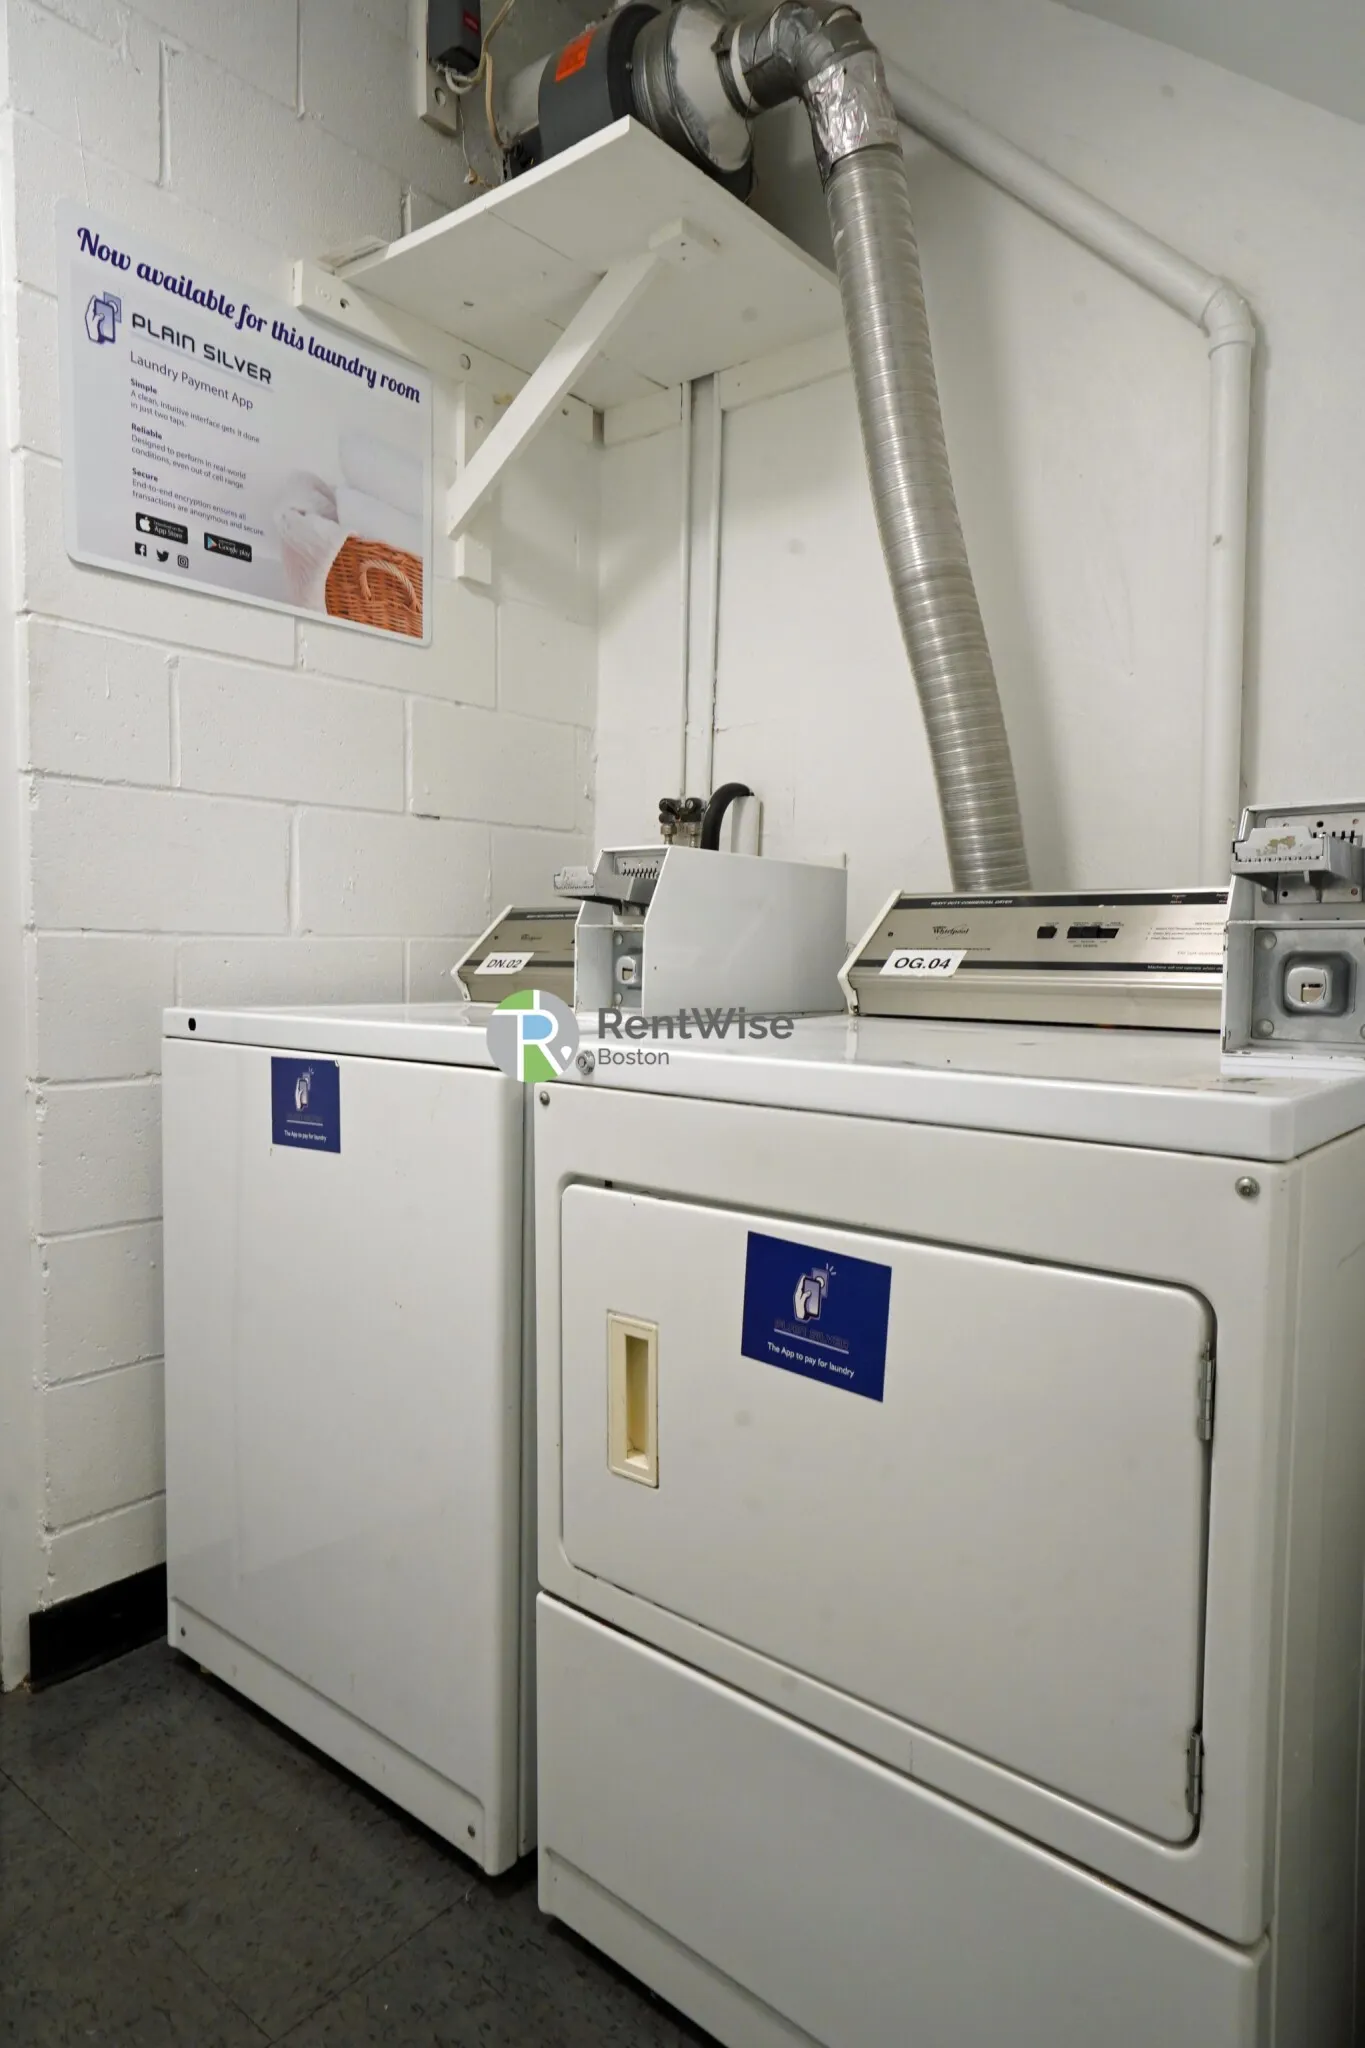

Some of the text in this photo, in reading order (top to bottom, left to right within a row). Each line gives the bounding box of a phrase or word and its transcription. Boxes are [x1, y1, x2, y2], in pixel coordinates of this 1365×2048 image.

[77, 227, 420, 403] Now available for this laundry room
[132, 313, 272, 385] PLAIN SILVER
[130, 350, 254, 410] Laundry Payment App
[130, 378, 157, 394] Simple
[130, 401, 138, 409] in
[138, 404, 153, 416] just
[154, 408, 168, 420] two
[130, 389, 137, 398] A
[138, 392, 159, 407] clean,
[160, 400, 189, 417] intuitive
[190, 411, 220, 429] interface
[221, 423, 236, 436] gets
[243, 431, 260, 443] done
[131, 422, 163, 441] Reliable
[131, 433, 167, 452] Designed
[176, 450, 204, 466] perform
[205, 459, 212, 467] in
[213, 461, 246, 480] real-world
[131, 446, 171, 466] conditions,
[172, 459, 189, 471] even
[190, 464, 203, 476] out
[204, 469, 211, 478] of
[212, 472, 223, 483] cell
[132, 467, 158, 482] Secure
[132, 478, 246, 520] End-to-end encryption ensures all
[132, 490, 176, 510] transactions
[177, 505, 188, 514] are
[189, 509, 228, 527] anonymous
[229, 520, 243, 530] and
[154, 525, 183, 539] App Store
[486, 959, 522, 969] DN.02
[894, 957, 951, 970] OG.04
[768, 1341, 855, 1379] The App to pay for laundry
